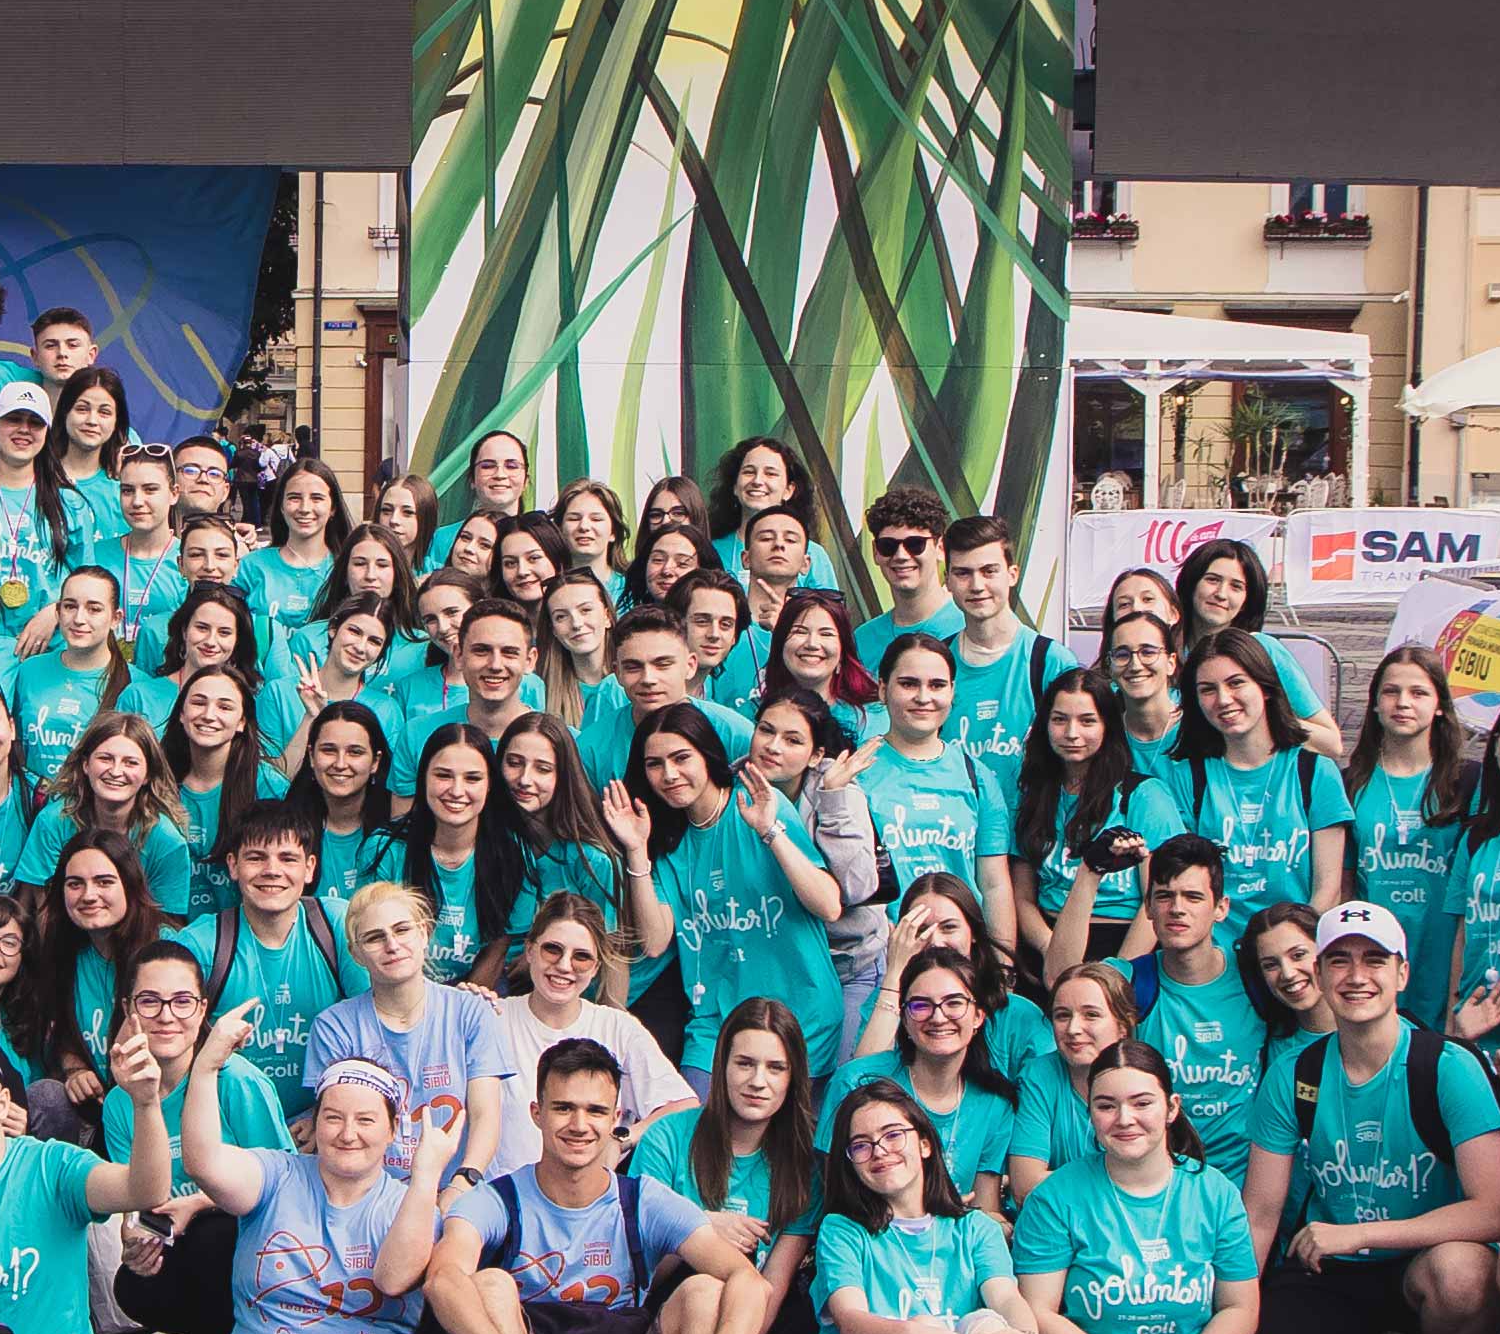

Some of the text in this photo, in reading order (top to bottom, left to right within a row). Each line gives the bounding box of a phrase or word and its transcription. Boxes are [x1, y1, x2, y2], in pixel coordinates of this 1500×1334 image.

[1361, 530, 1481, 563] SAM
[1360, 571, 1411, 582] TRAN
[1455, 649, 1492, 681] SIBIU
[1390, 888, 1427, 904] colt
[265, 1063, 300, 1078] colt
[384, 1154, 412, 1171] leag
